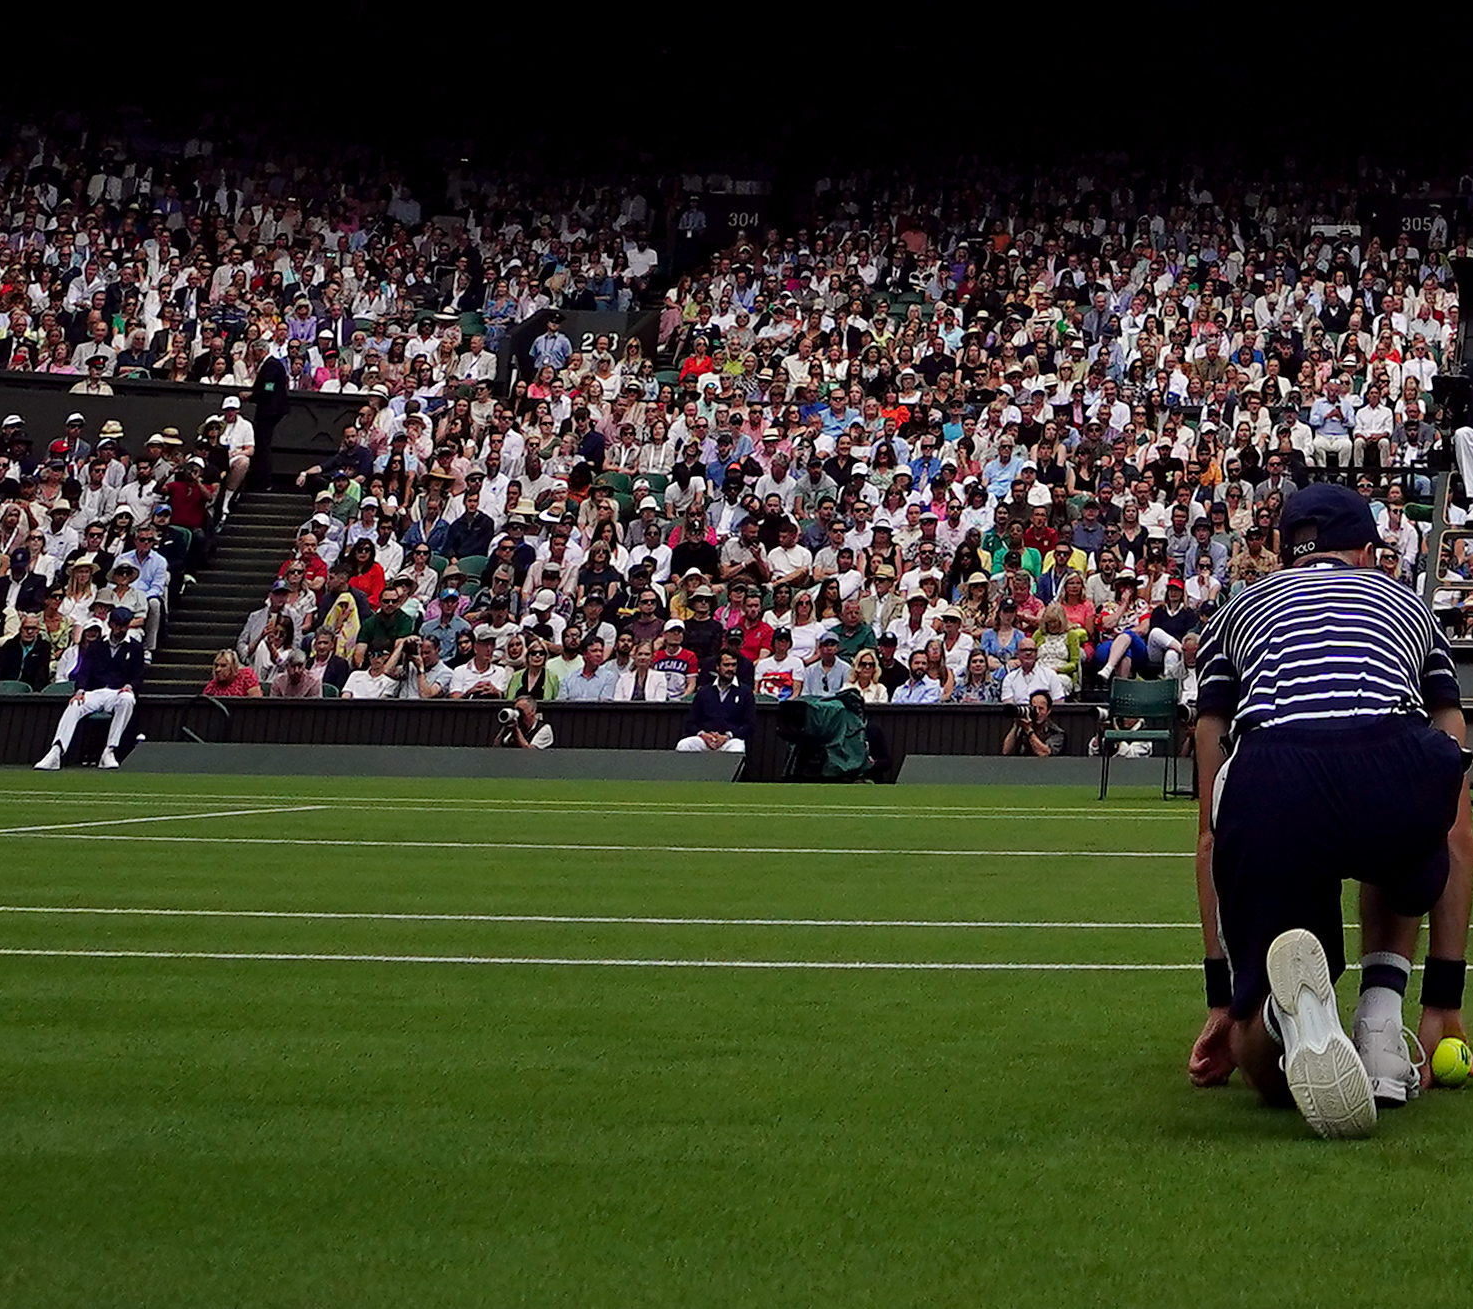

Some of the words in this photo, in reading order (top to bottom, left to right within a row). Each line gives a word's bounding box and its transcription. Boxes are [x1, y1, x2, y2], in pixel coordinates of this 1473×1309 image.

[728, 212, 758, 226] 304
[1402, 217, 1432, 232] 305
[581, 332, 619, 351] 23
